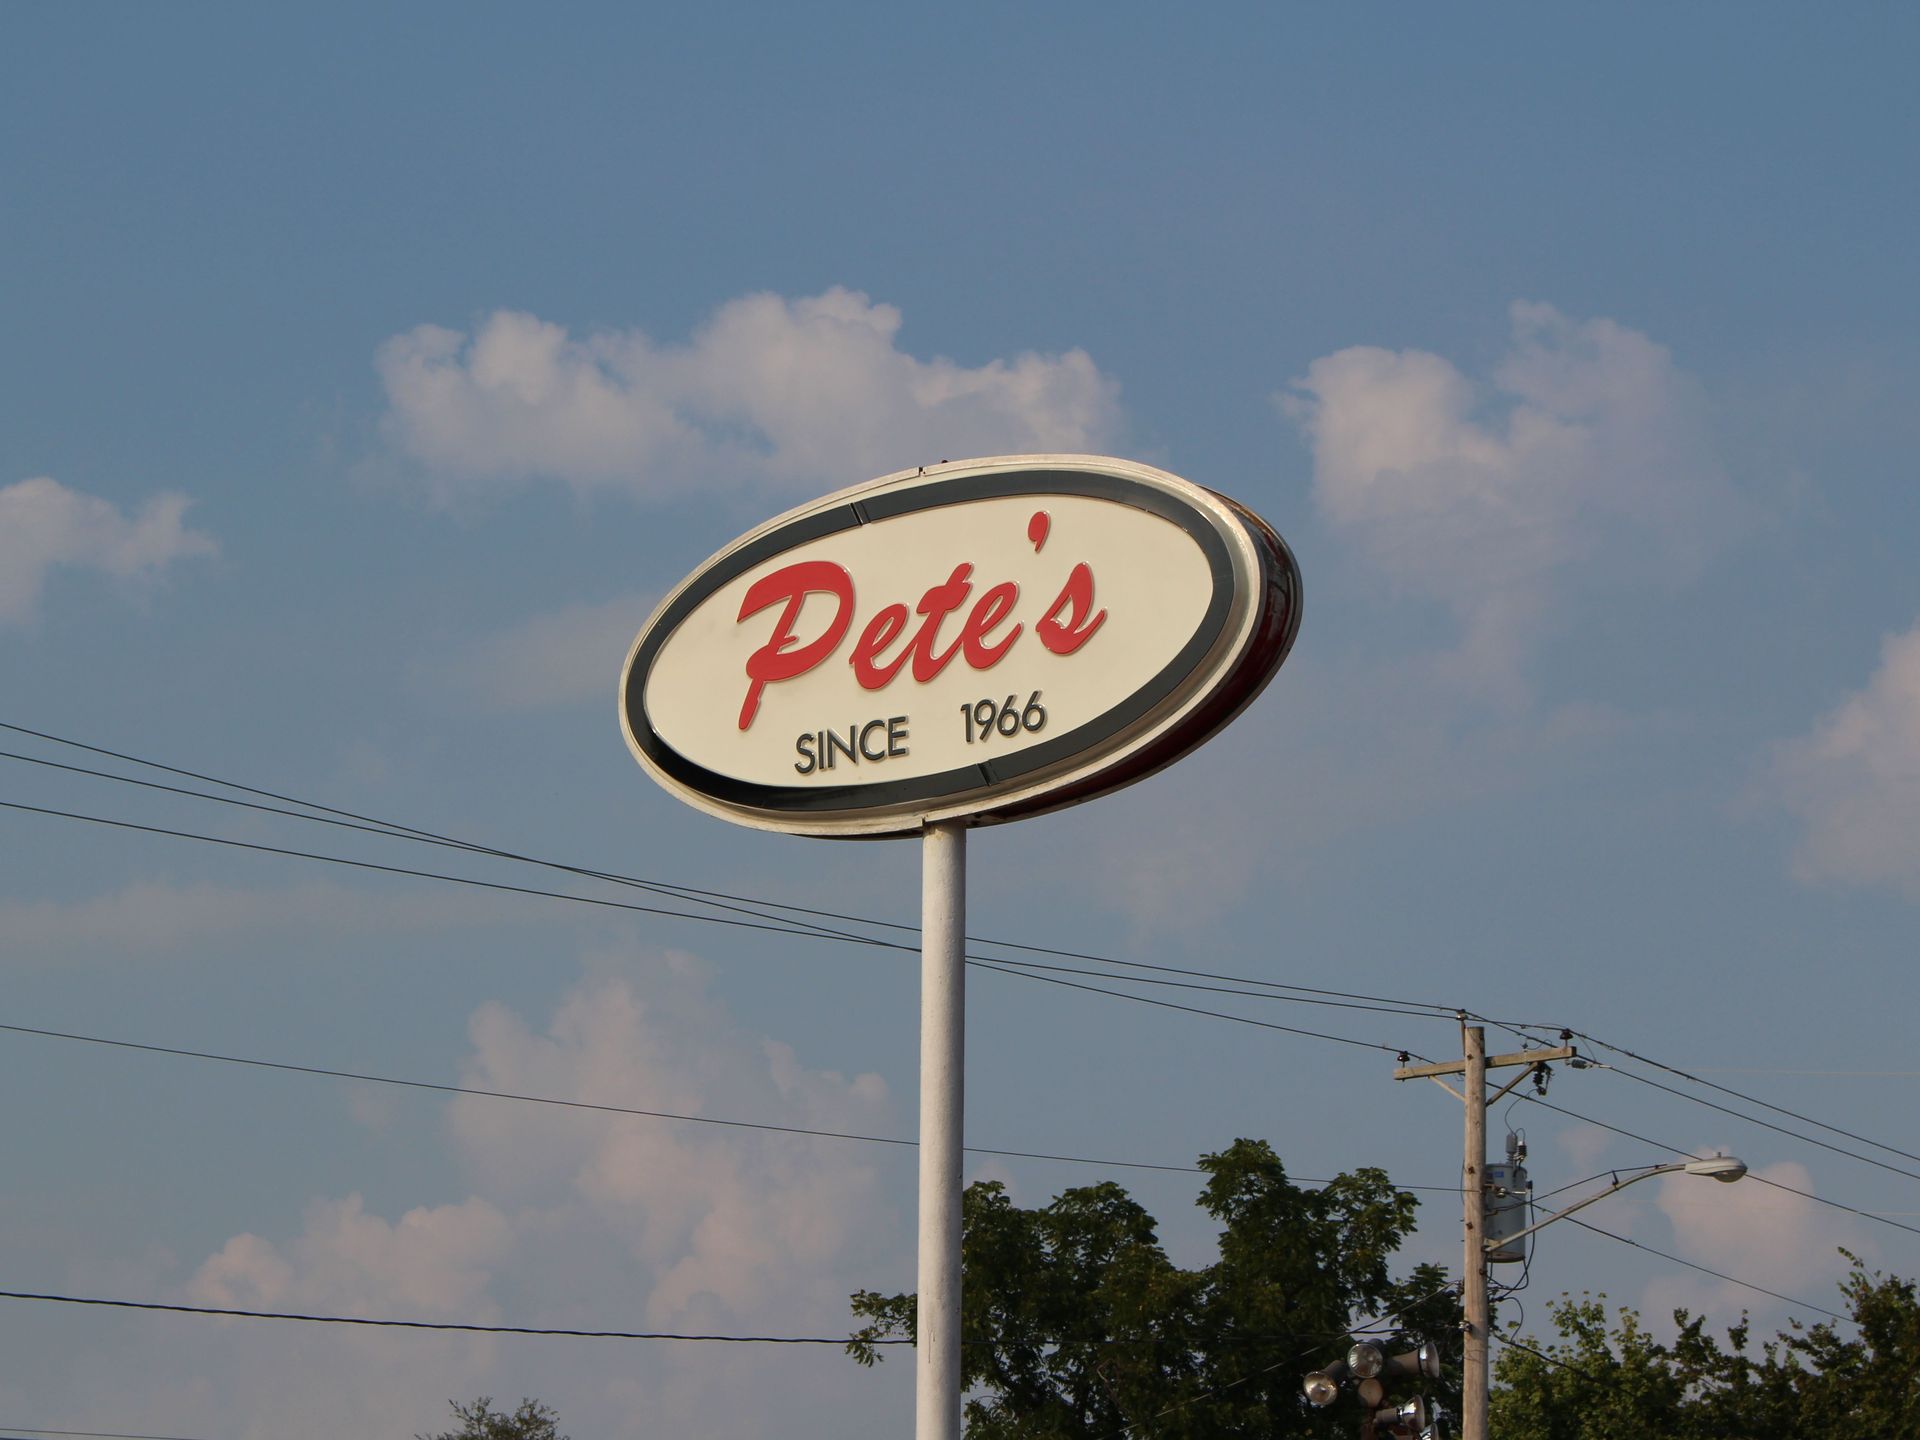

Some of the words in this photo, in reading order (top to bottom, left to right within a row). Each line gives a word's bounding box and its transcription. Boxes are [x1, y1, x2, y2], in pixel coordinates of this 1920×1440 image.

[737, 511, 1107, 730] Pete's
[794, 716, 909, 774] SINCE
[960, 690, 1047, 743] 1966
